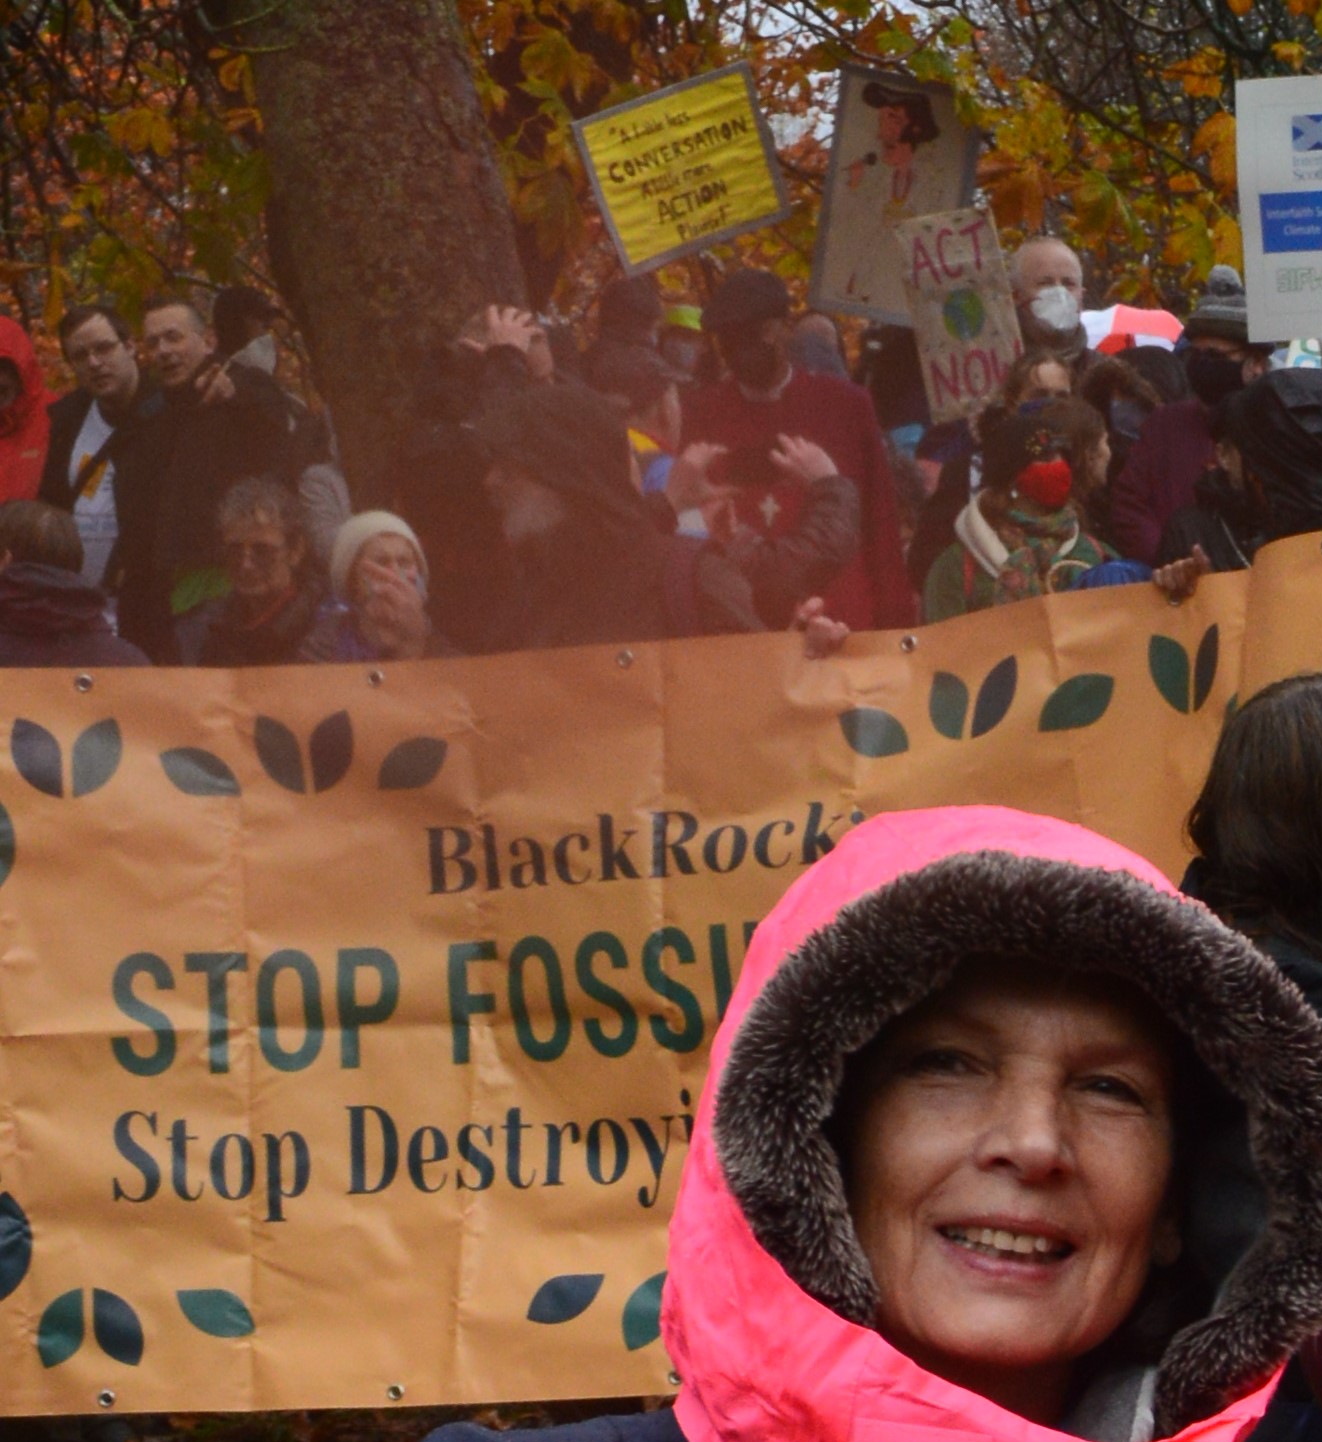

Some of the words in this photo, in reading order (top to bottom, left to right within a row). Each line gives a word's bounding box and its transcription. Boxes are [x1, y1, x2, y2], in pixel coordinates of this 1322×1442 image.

[607, 115, 748, 184] CONVERSATION
[657, 179, 728, 225] ACTION
[1283, 222, 1321, 237] Climate
[911, 220, 986, 290] ACT
[111, 945, 399, 1078] STOP
[113, 1108, 311, 1222] Stop
[346, 1087, 694, 1210] Destroyi
